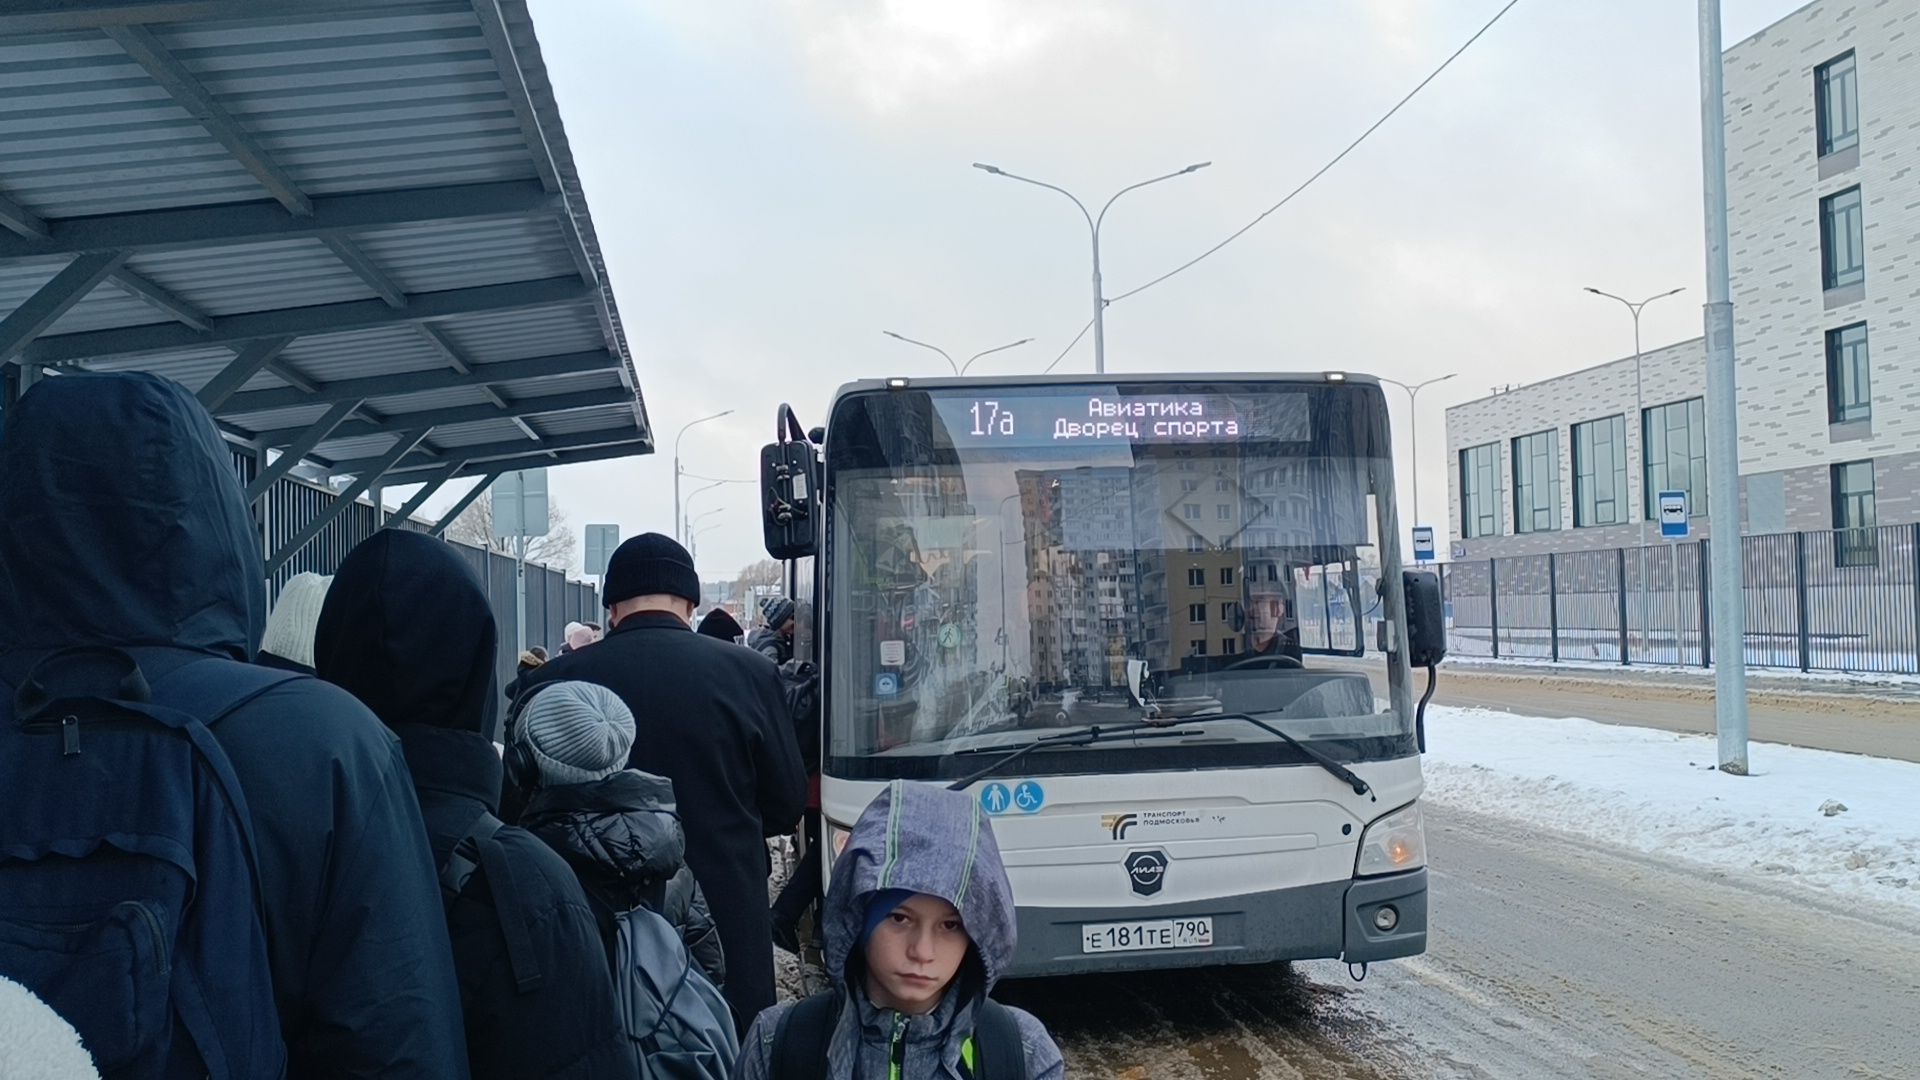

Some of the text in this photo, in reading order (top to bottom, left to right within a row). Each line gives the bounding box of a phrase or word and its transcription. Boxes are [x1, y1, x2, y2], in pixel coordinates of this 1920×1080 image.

[1088, 398, 1203, 417] Авиатика
[970, 401, 1014, 436] 17а
[1053, 418, 1239, 439] Дворец спорта
[1143, 810, 1187, 818] ТРАНСПОРТ
[1143, 818, 1200, 826] ПОДМОСКОВЬЯ
